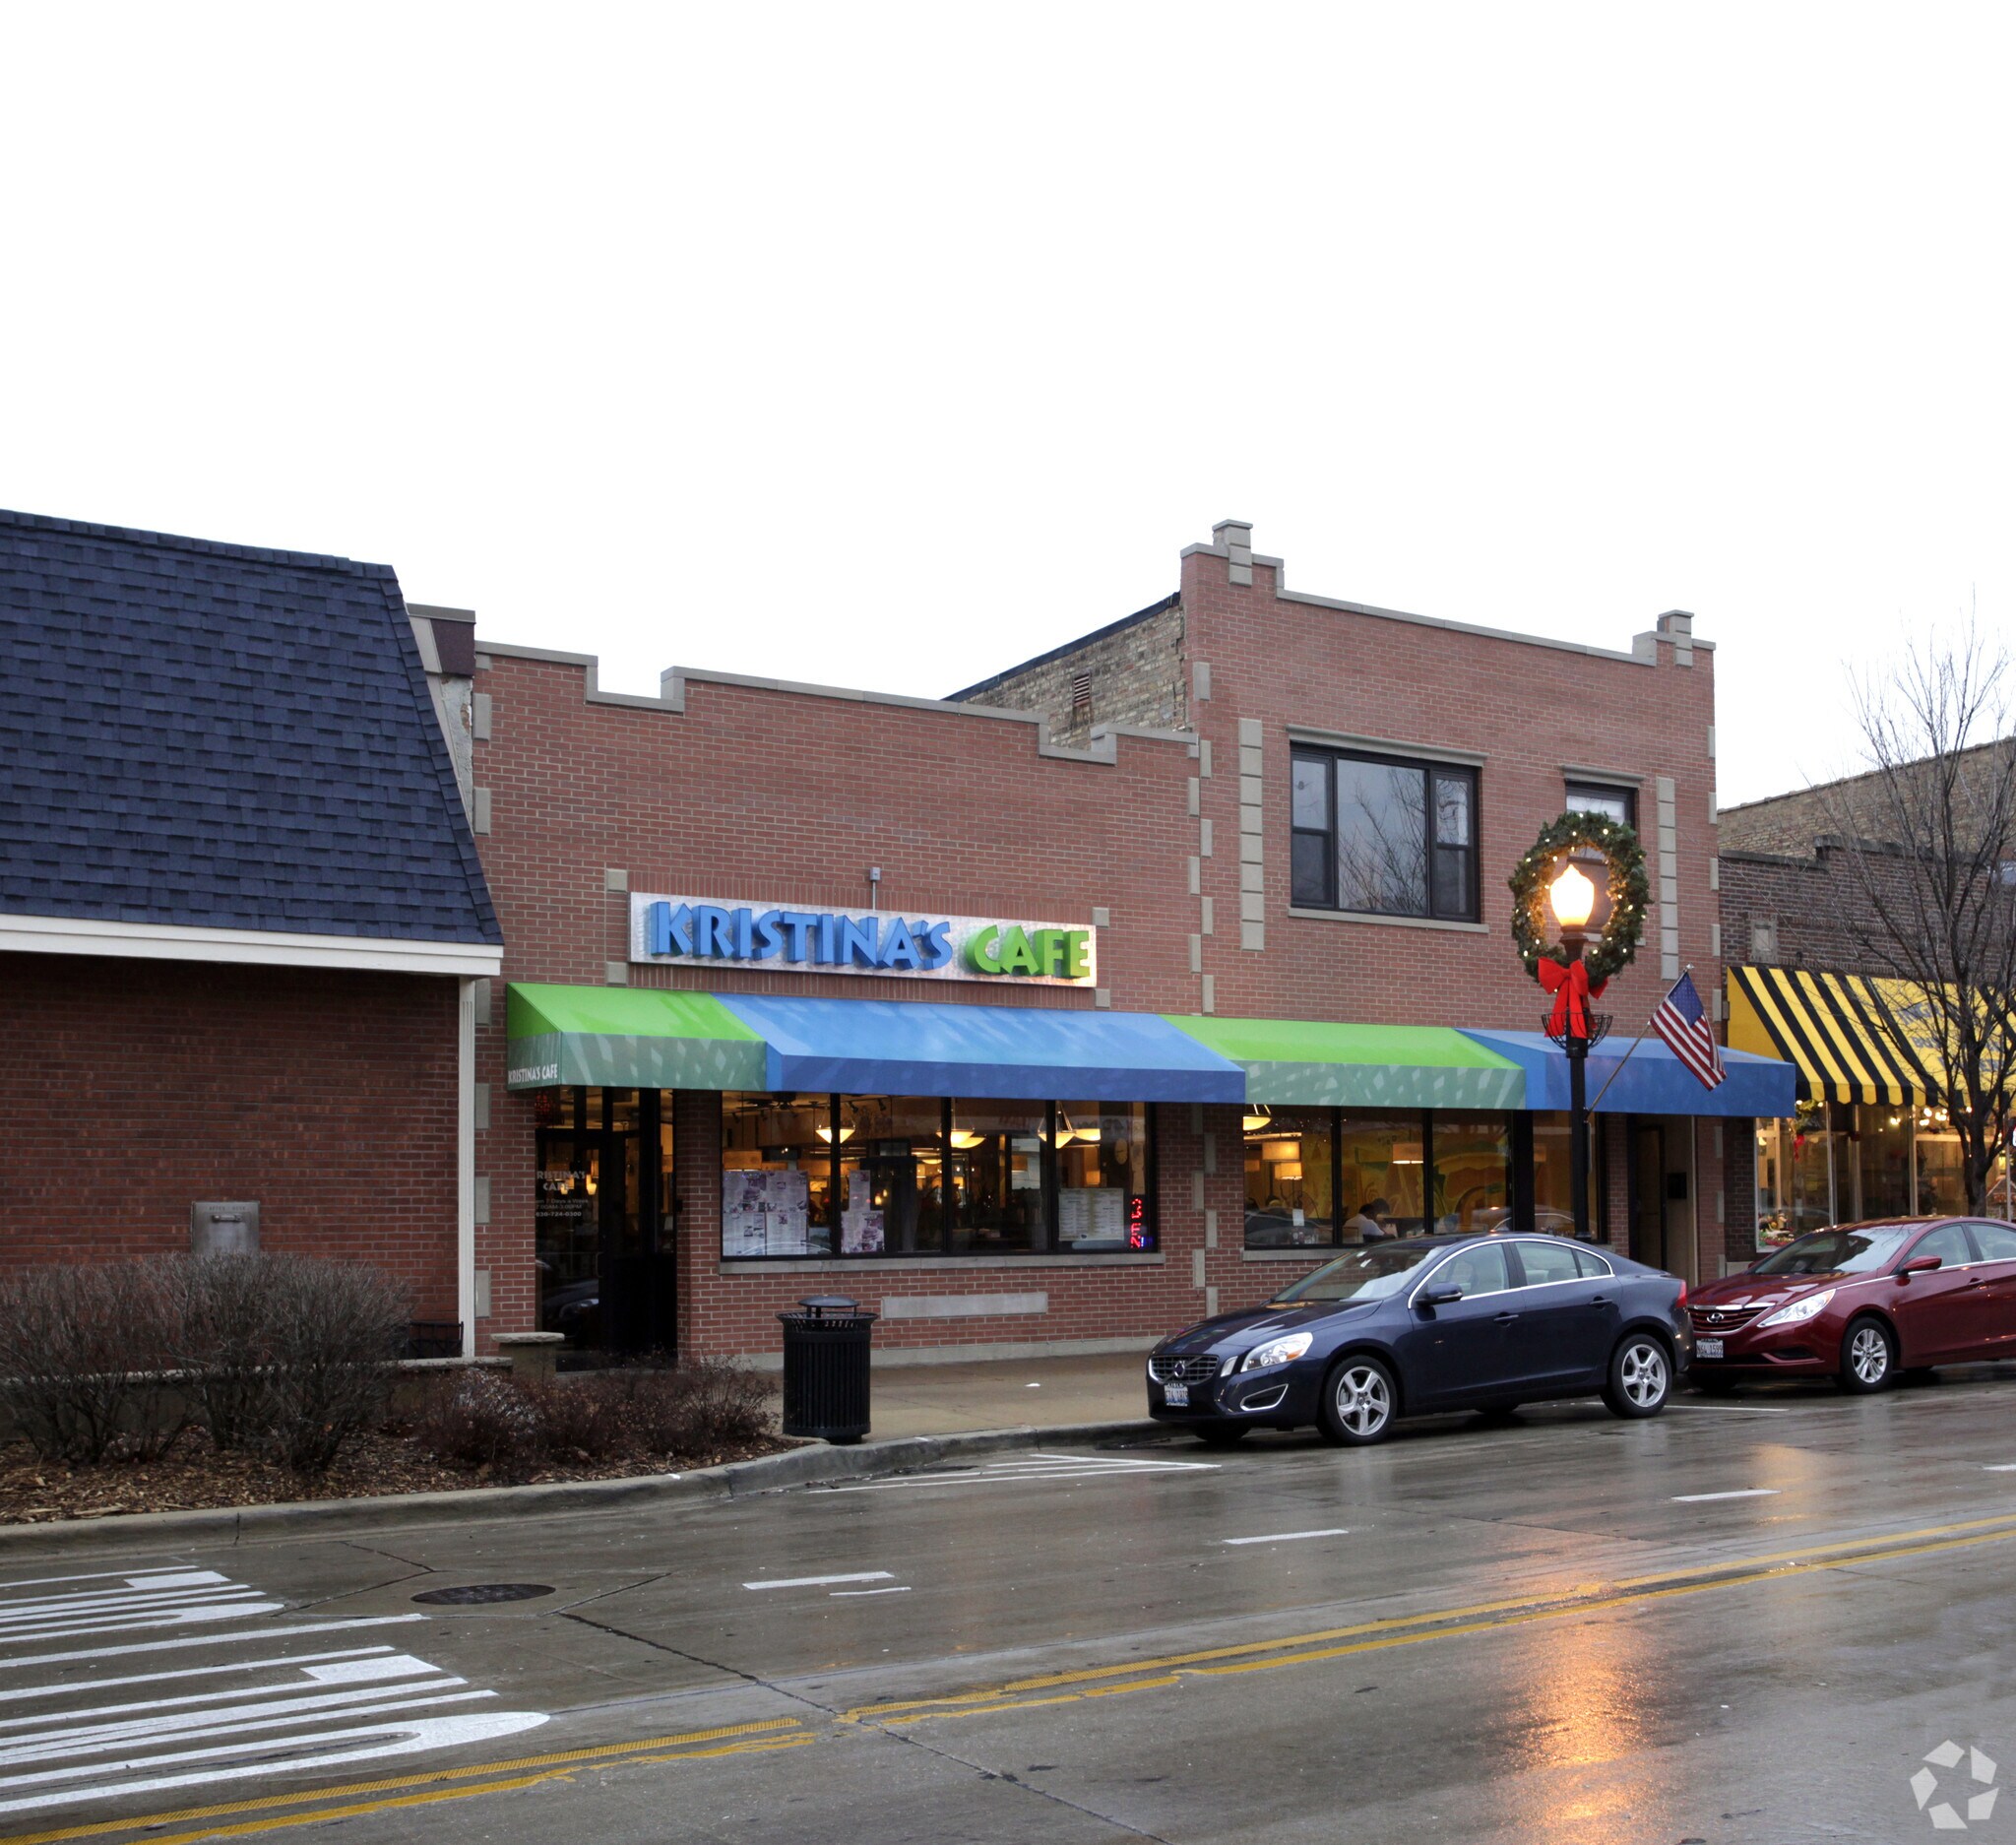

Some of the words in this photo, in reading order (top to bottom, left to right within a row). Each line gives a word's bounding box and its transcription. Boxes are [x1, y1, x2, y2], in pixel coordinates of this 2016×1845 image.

[649, 901, 954, 971] KRISTINA'S
[966, 924, 1091, 978] CAFE
[508, 1066, 540, 1085] KRISTINA'S
[541, 1063, 558, 1080] CAFE
[537, 1171, 585, 1179] RISTINA'S
